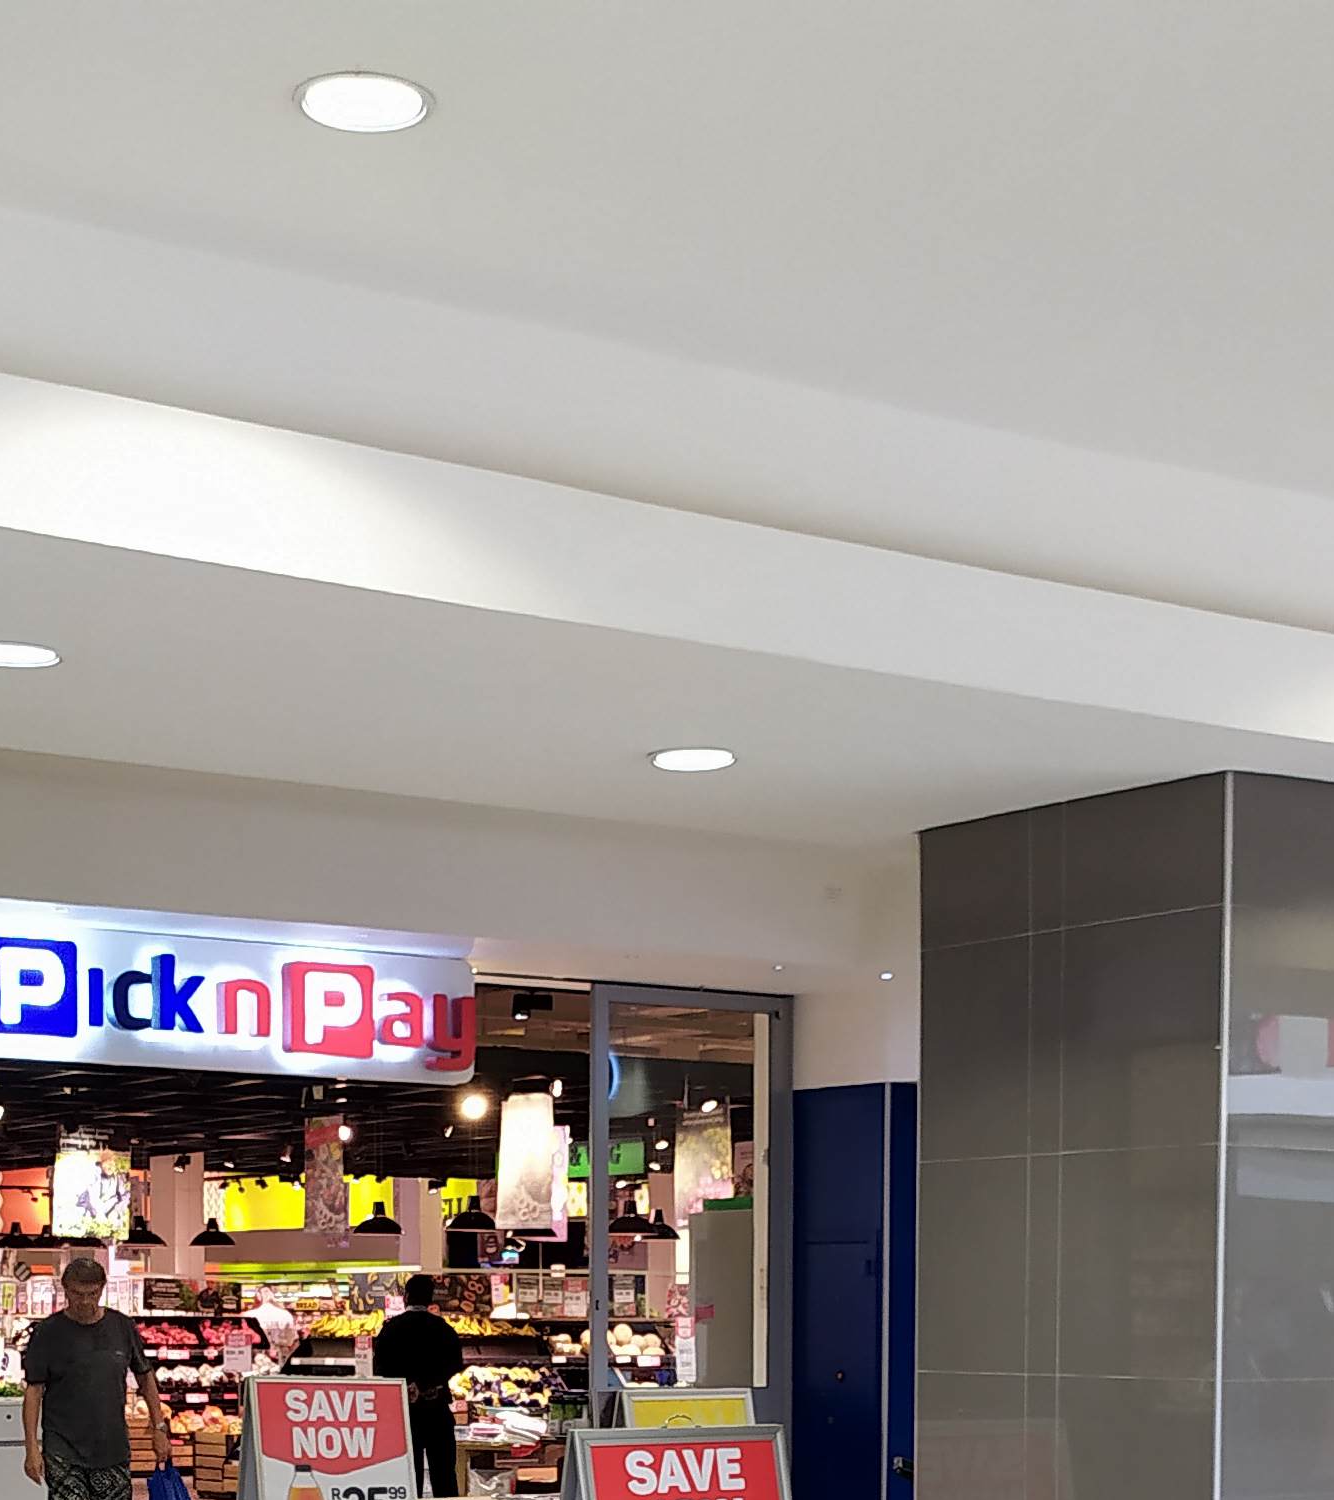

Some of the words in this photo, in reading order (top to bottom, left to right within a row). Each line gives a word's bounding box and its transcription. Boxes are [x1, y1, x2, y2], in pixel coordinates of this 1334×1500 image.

[216, 977, 271, 1038] n
[281, 960, 477, 1072] Pay
[284, 1388, 377, 1423] SAVE
[292, 1426, 376, 1459] NOW
[624, 1446, 746, 1496] SAVE
